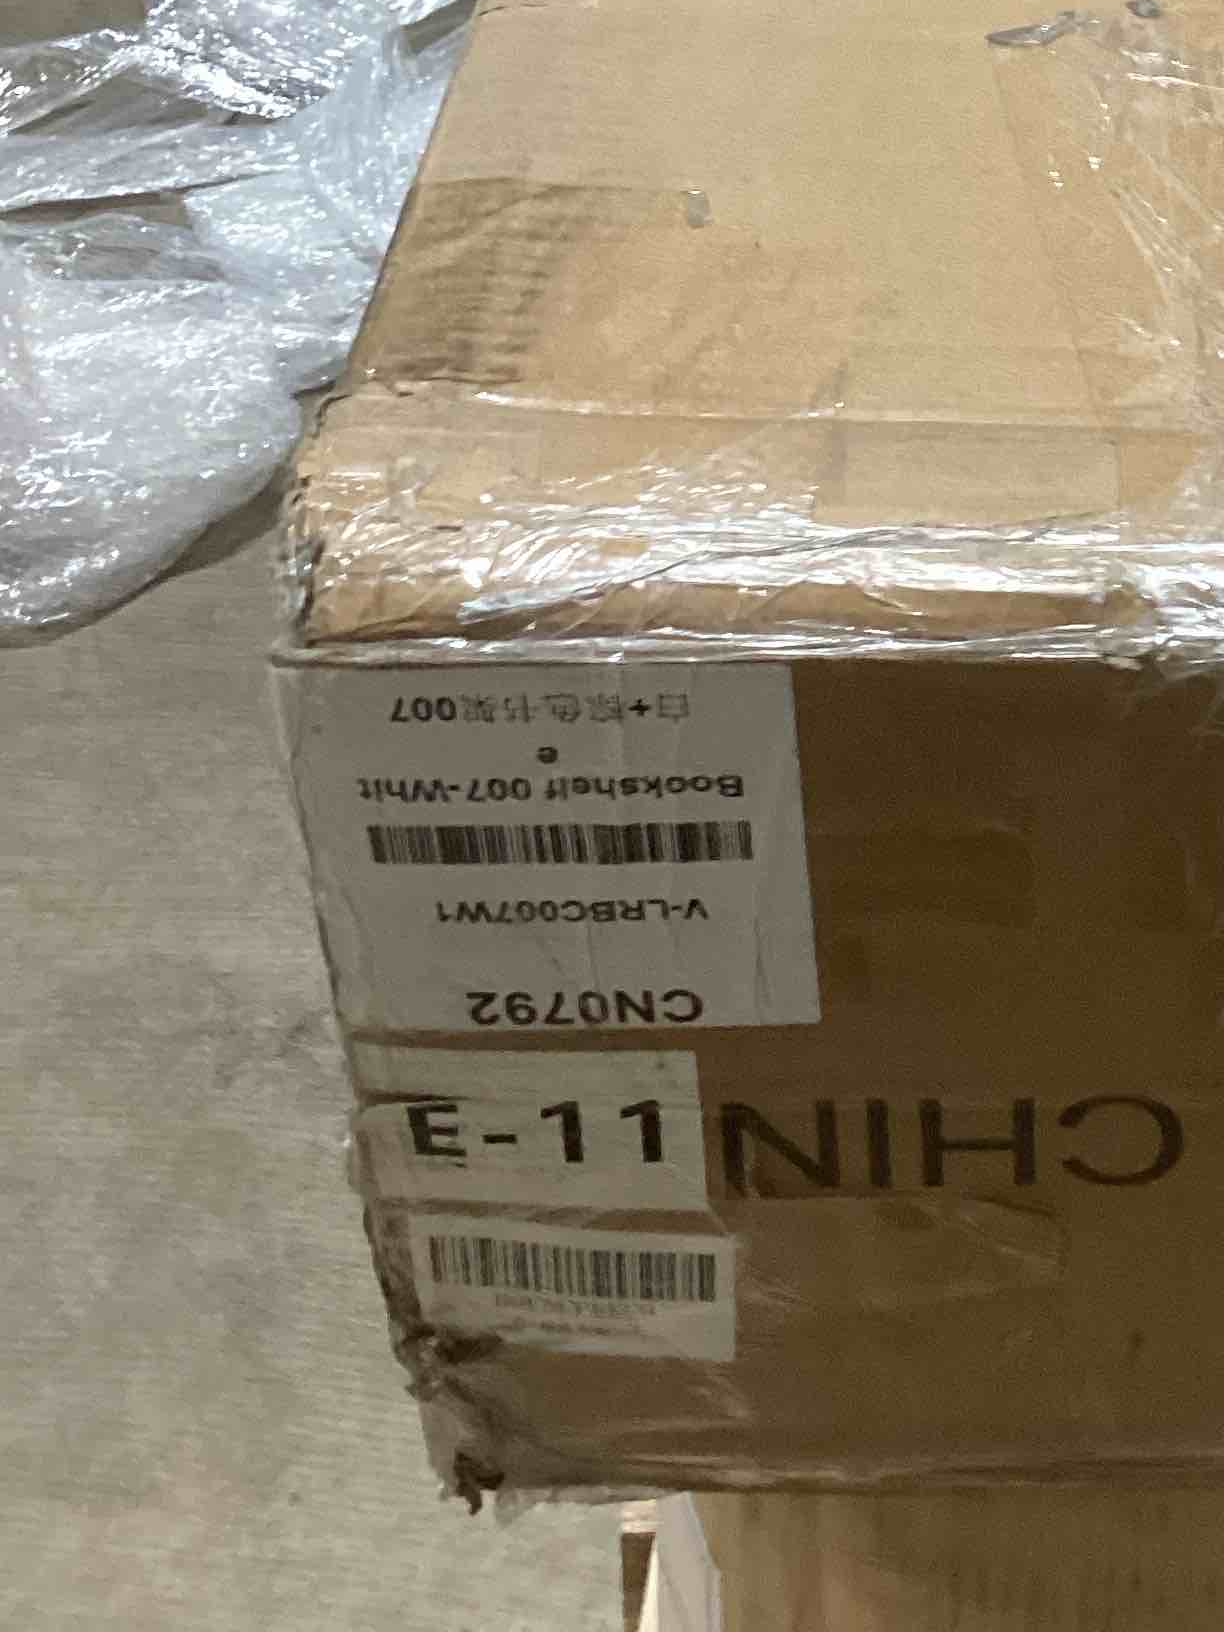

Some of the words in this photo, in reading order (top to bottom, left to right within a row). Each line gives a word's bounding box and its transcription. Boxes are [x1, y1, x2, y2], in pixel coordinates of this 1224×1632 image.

[536, 746, 559, 764] e
[357, 775, 532, 802] 007-Whit
[544, 774, 745, 800] Bookshelf
[435, 898, 710, 924] V-LRBC007W1
[464, 989, 704, 1026] CN0792
[406, 1098, 664, 1165] E-11
[719, 1095, 1185, 1199] CHIN
